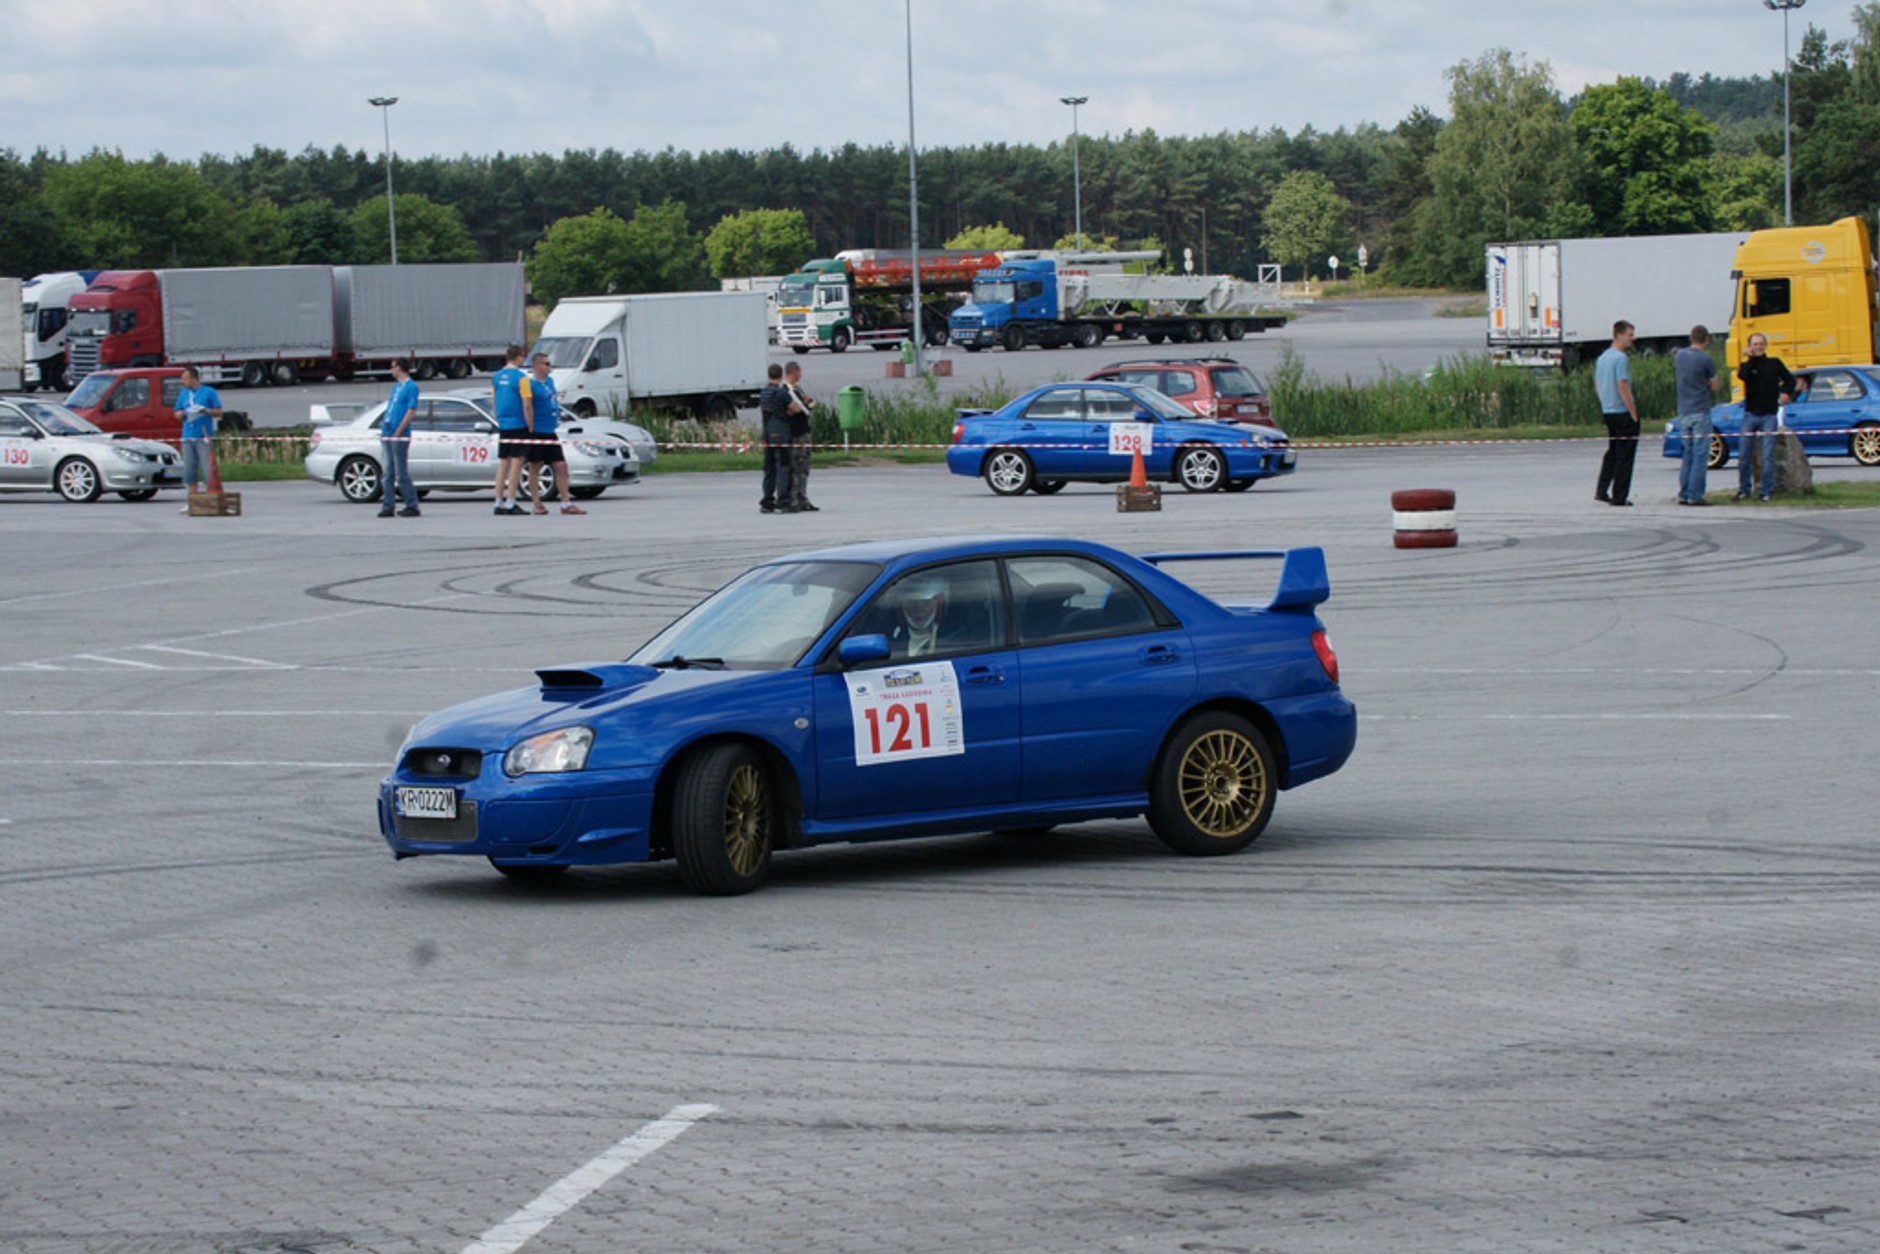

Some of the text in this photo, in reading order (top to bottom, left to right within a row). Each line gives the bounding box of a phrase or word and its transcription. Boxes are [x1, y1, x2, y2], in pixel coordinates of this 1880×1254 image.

[1113, 434, 1141, 451] 128
[4, 447, 29, 465] 130
[462, 446, 488, 464] 129
[865, 702, 931, 754] 121
